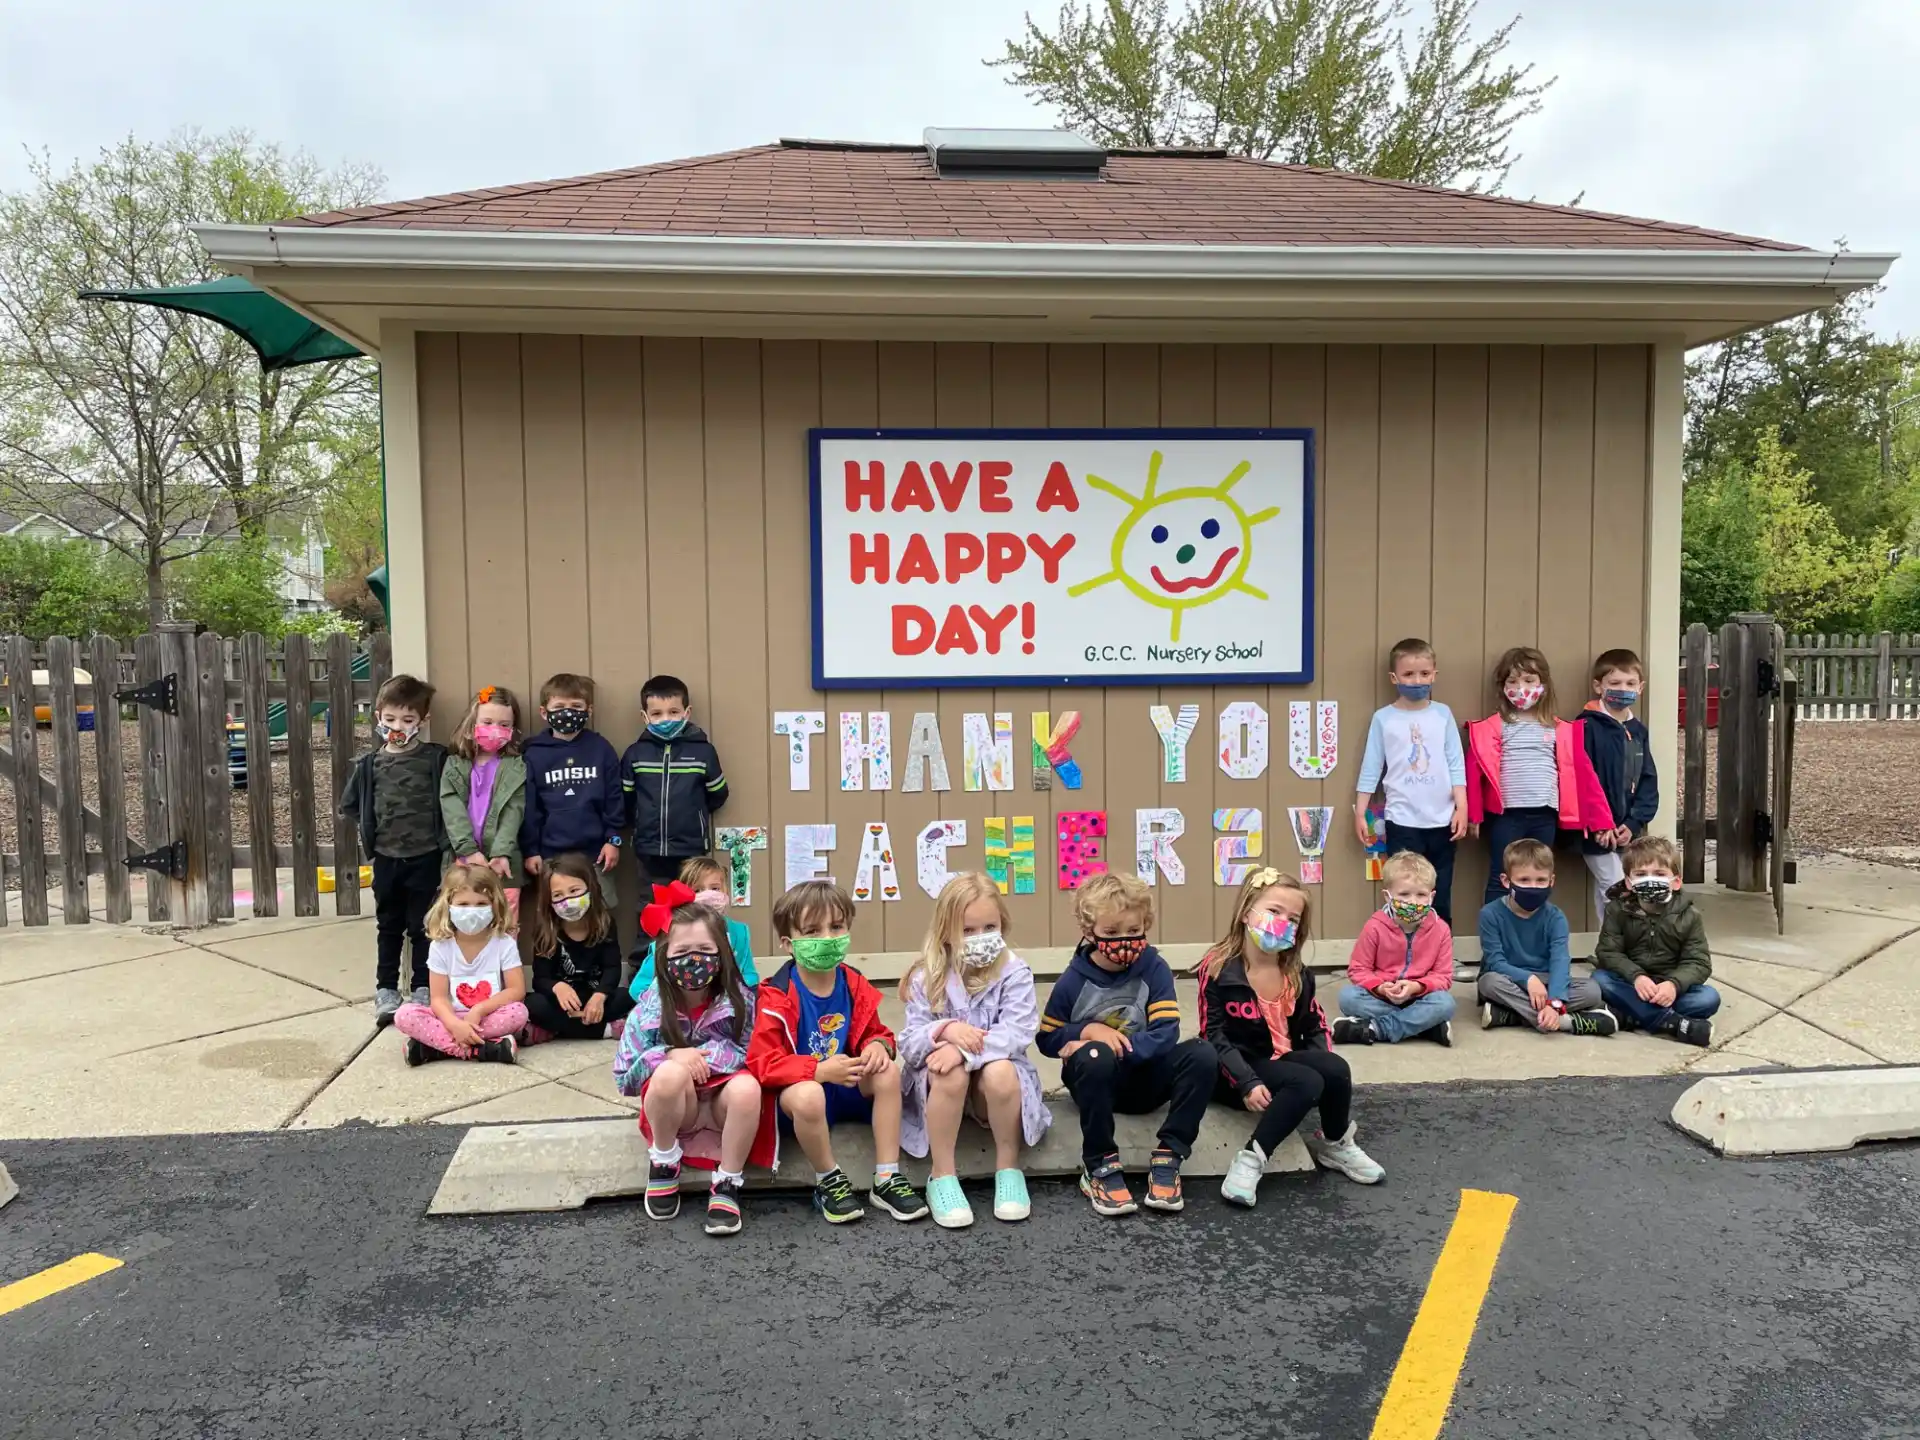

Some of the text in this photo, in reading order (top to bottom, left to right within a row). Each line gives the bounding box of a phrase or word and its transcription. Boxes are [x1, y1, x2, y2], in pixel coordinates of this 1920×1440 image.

[844, 461, 1080, 513] HAVE A
[850, 532, 1076, 585] HAPPY
[891, 602, 1036, 656] DAY!
[1084, 640, 1263, 664] G.C.C. Nursery School
[773, 701, 1340, 793] THANK YOU
[545, 766, 598, 784] IRISH
